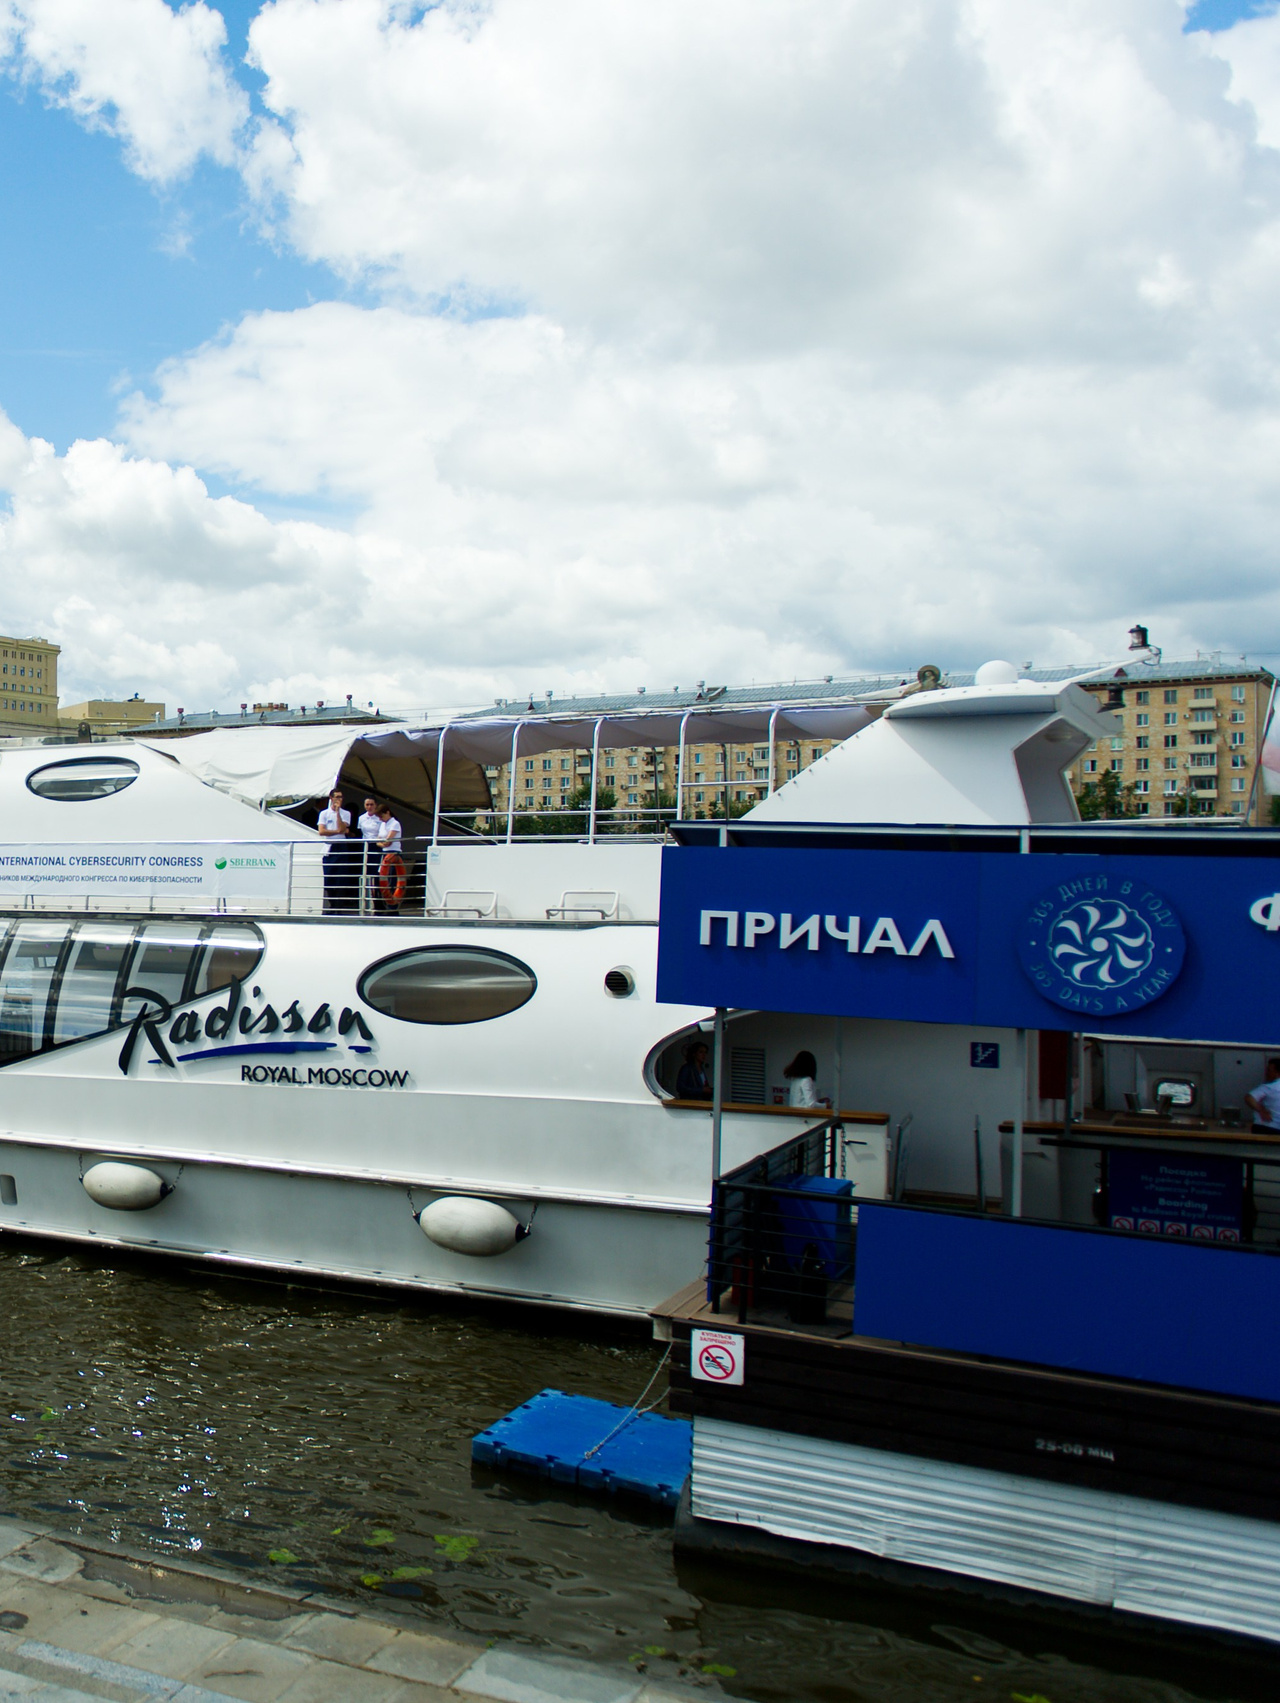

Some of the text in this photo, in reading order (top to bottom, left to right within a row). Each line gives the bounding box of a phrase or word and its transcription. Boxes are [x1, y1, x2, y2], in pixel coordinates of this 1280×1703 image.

[68, 856, 147, 867] CYBERSECURITY
[148, 856, 203, 867] CONGRESS
[229, 858, 277, 867] SBERBANK
[20, 875, 81, 883] МЕЖДУНАРОДНОГО
[119, 875, 129, 883] ПО
[129, 875, 203, 884] КИБЕРБЕЗОПАСНОСТИ
[1028, 874, 1178, 928] 365 ДНЕЙ В ГОДУ
[699, 909, 956, 959] ПРИЧАЛ
[1029, 961, 1174, 1012] 365 DAYS A YEAR
[118, 974, 374, 1076] Radisson
[240, 1064, 410, 1088] ROYAL MOSCOW
[1159, 1166, 1207, 1177] Посадка
[1158, 1198, 1208, 1211] Boarding
